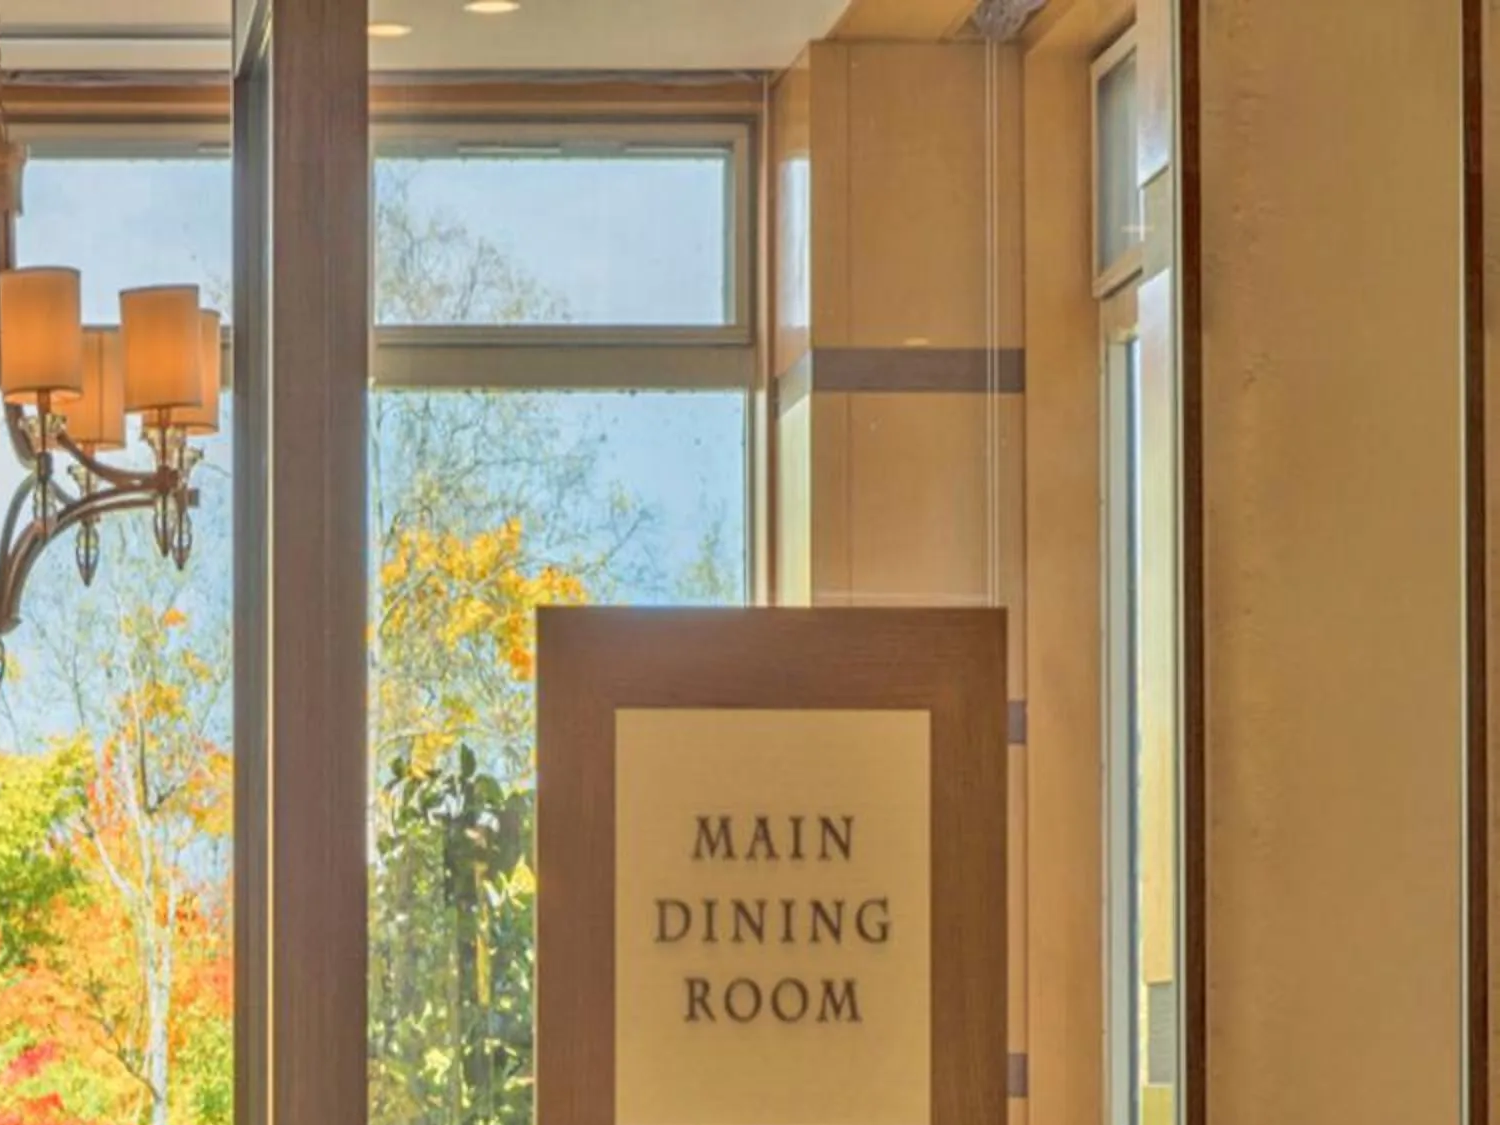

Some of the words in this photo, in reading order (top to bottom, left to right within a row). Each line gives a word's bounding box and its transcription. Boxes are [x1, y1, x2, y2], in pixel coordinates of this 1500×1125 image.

[693, 816, 854, 860] MAIN
[656, 898, 891, 944] DINING
[685, 977, 862, 1023] ROOM
